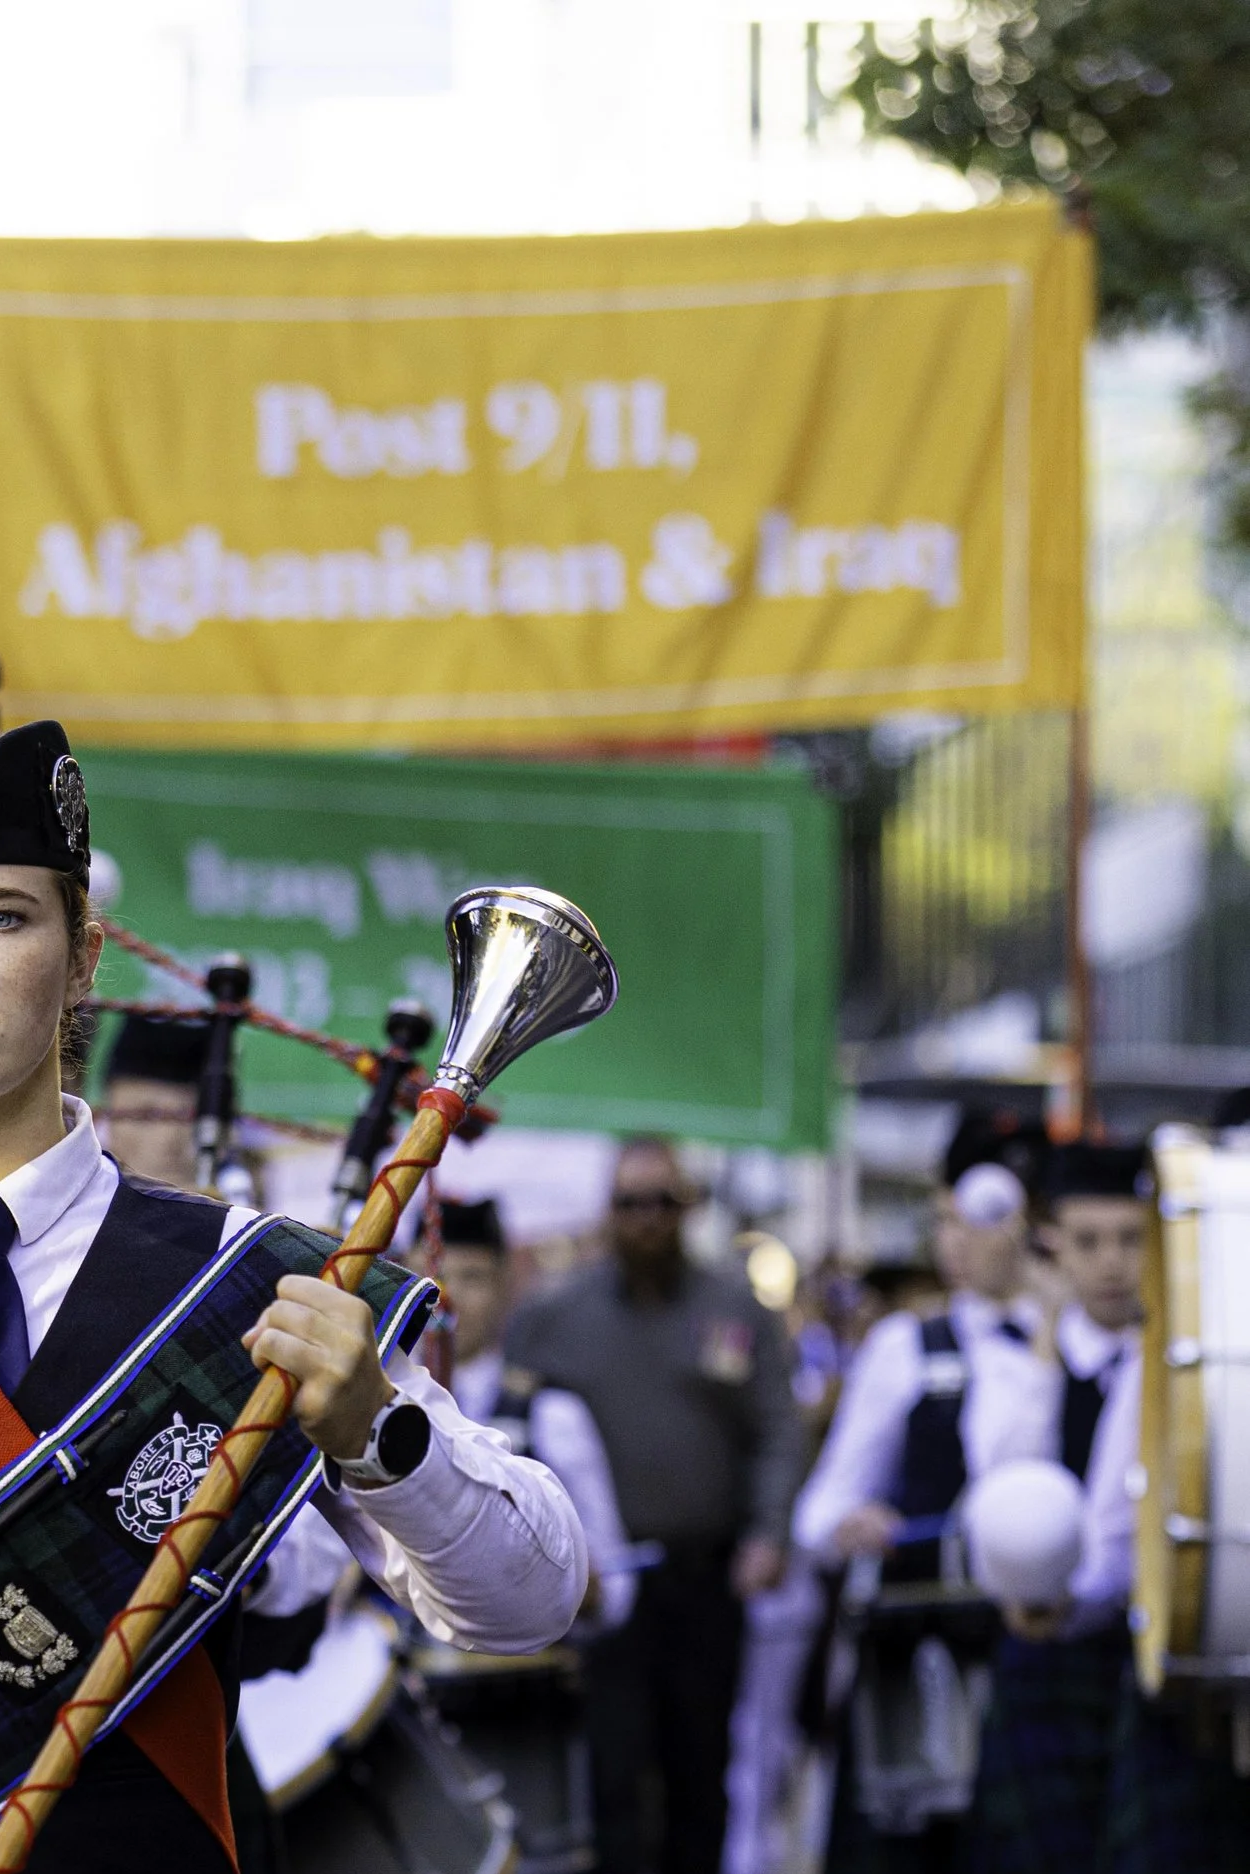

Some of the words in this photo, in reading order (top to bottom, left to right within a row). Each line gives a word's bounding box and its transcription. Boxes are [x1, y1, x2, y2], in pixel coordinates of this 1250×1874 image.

[256, 378, 472, 480] Post
[18, 520, 626, 642] Afghanistan
[640, 511, 734, 610] &
[755, 507, 963, 609] Iraq
[185, 838, 362, 940] Iraq
[124, 1443, 158, 1499] LABORE
[160, 1429, 176, 1445] ET
